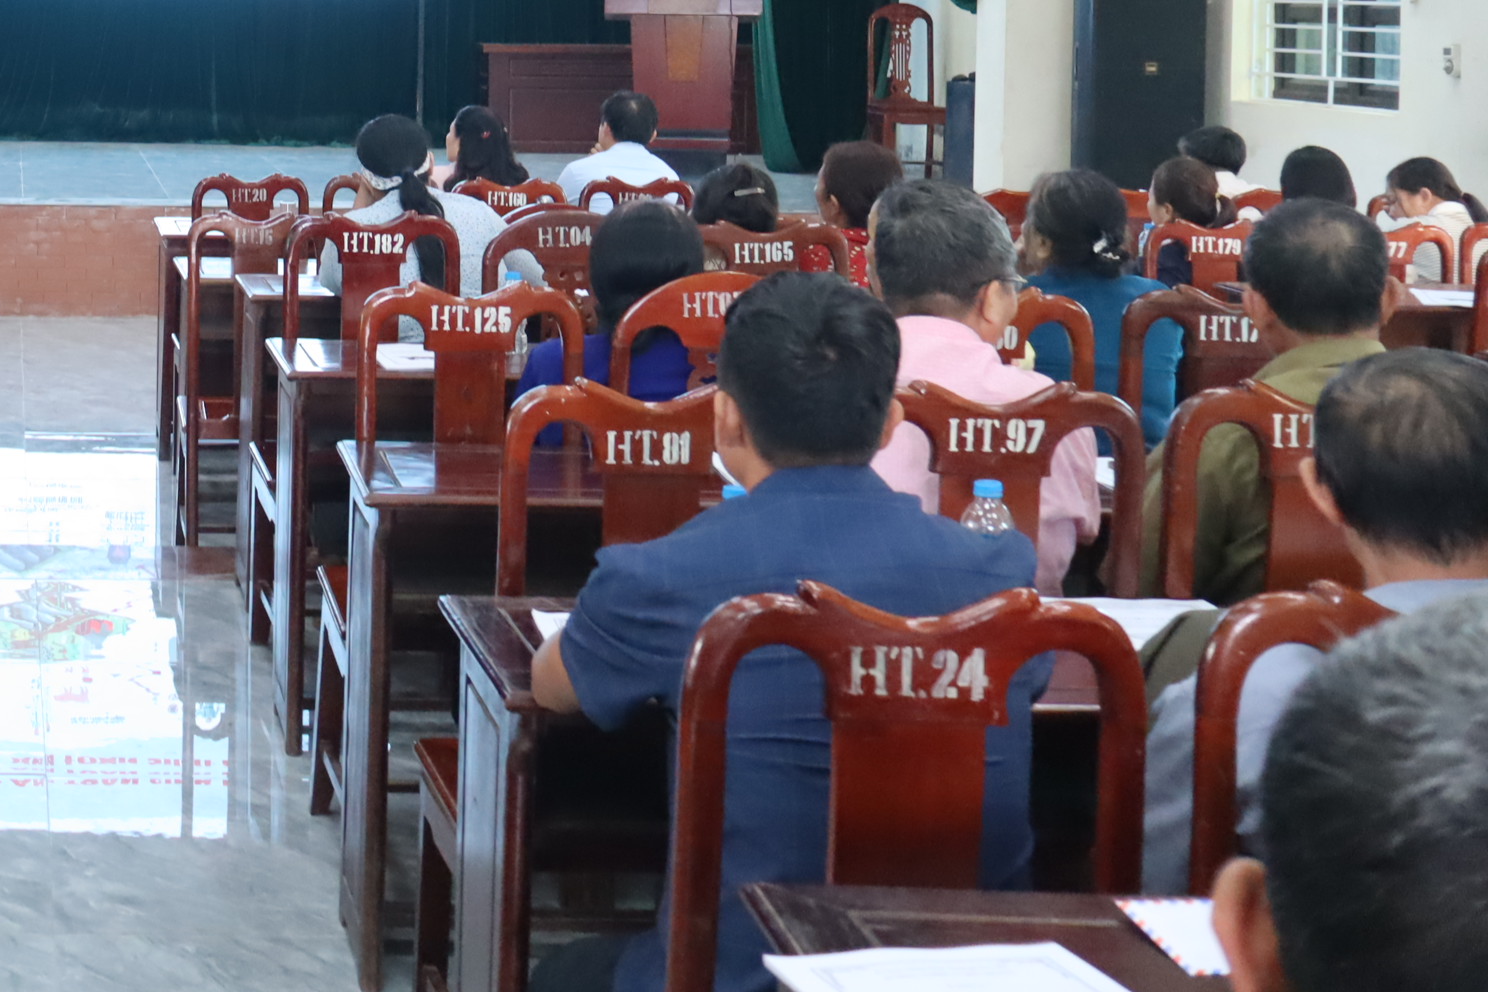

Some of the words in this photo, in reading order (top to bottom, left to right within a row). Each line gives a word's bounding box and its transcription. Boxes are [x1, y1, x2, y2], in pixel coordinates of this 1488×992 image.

[343, 231, 405, 255] HT.182
[734, 241, 794, 264] HT.165
[1192, 236, 1242, 255] HT.179
[431, 305, 512, 334] HT.125
[948, 417, 1046, 454] HT.97
[846, 645, 990, 702] HT.24
